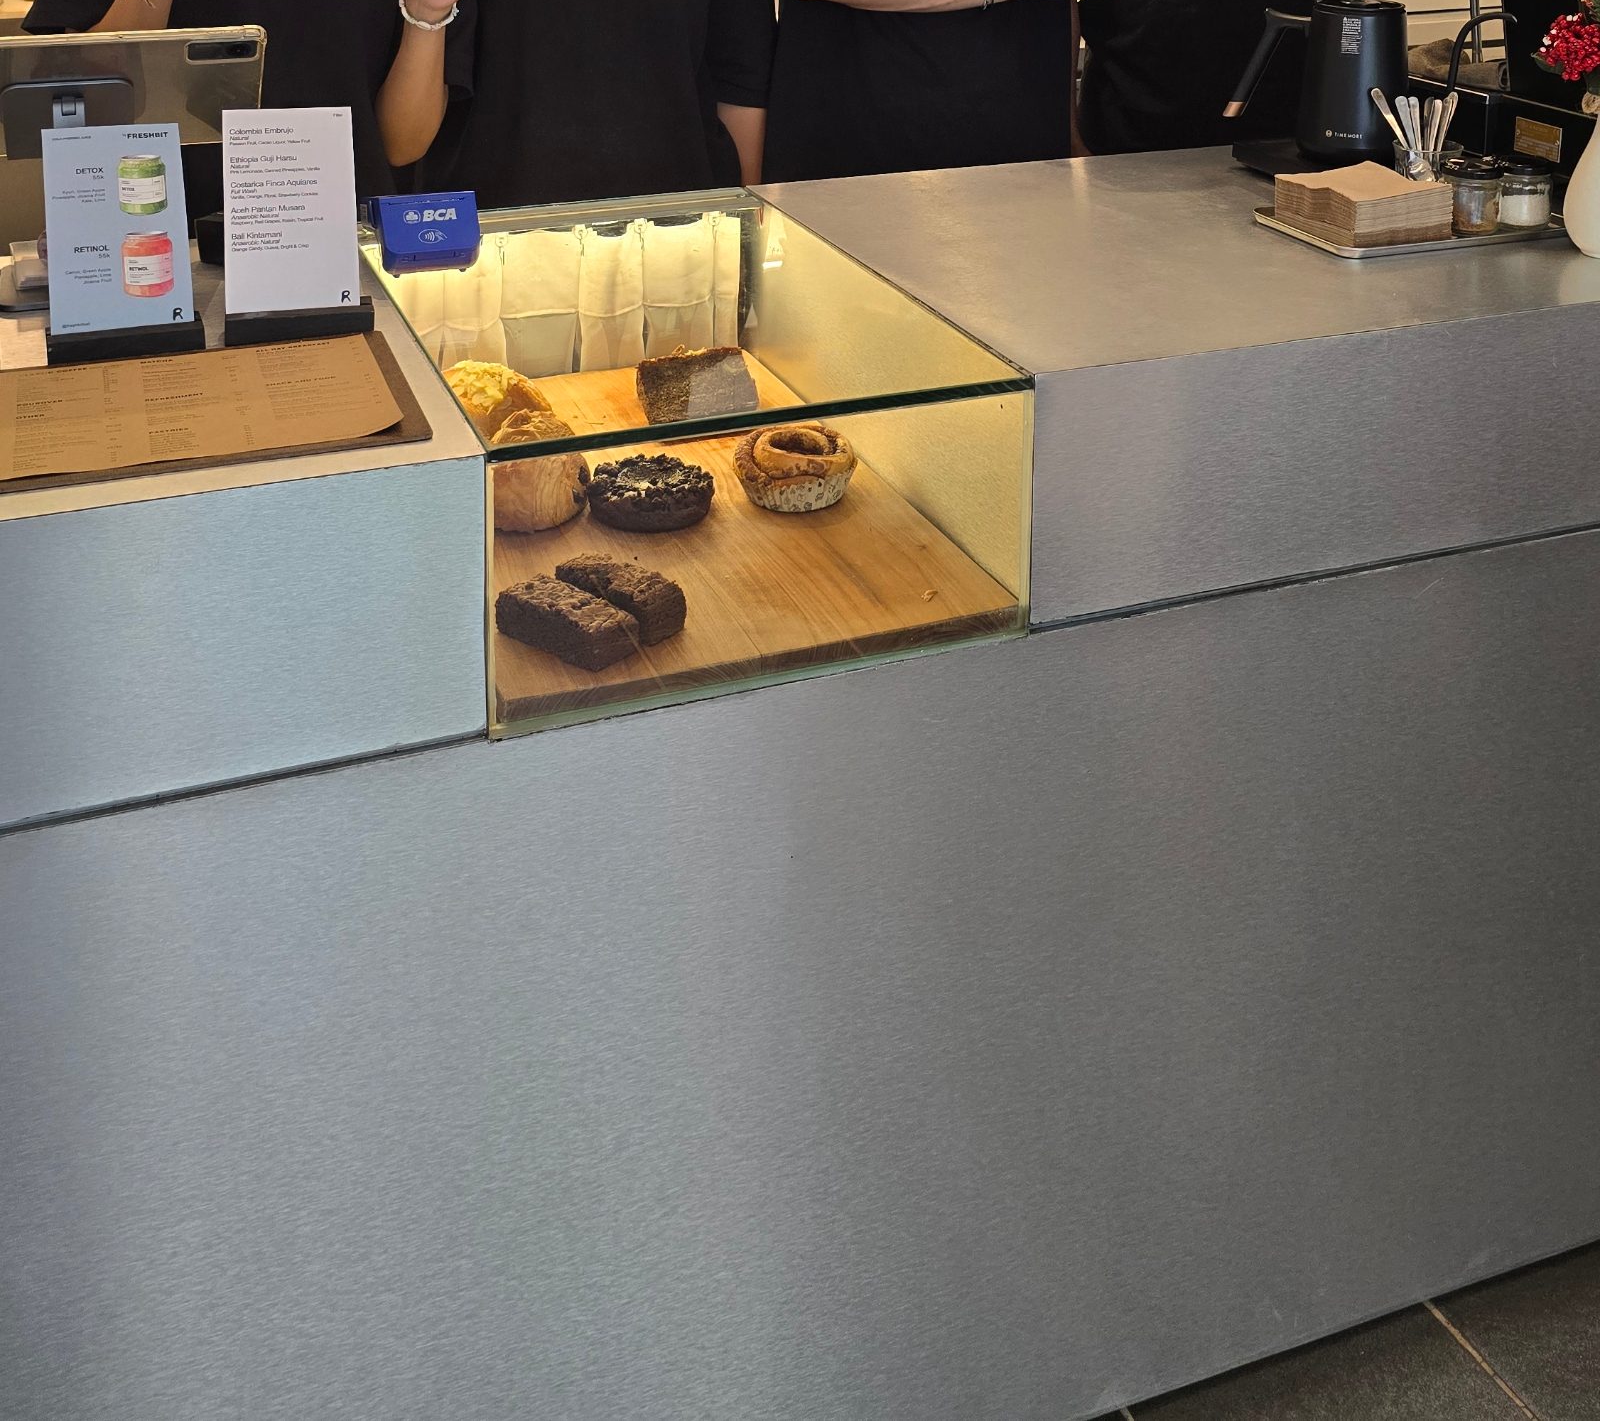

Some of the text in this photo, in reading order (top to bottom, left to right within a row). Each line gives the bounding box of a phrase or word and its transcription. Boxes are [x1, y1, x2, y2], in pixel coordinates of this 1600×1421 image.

[127, 131, 168, 139] FRESHBIT
[264, 127, 294, 135] Embrujo
[229, 156, 259, 164] Ethiopia
[260, 154, 275, 163] Guji
[75, 167, 104, 175] DETOX
[231, 206, 250, 214] Aceh
[251, 205, 277, 213] Pantan
[422, 208, 457, 222] BCA
[231, 231, 283, 240] Bali Kintamani
[231, 239, 259, 247] Anaerobic
[73, 244, 110, 253] RETINOL
[341, 290, 351, 303] R
[172, 307, 183, 320] R
